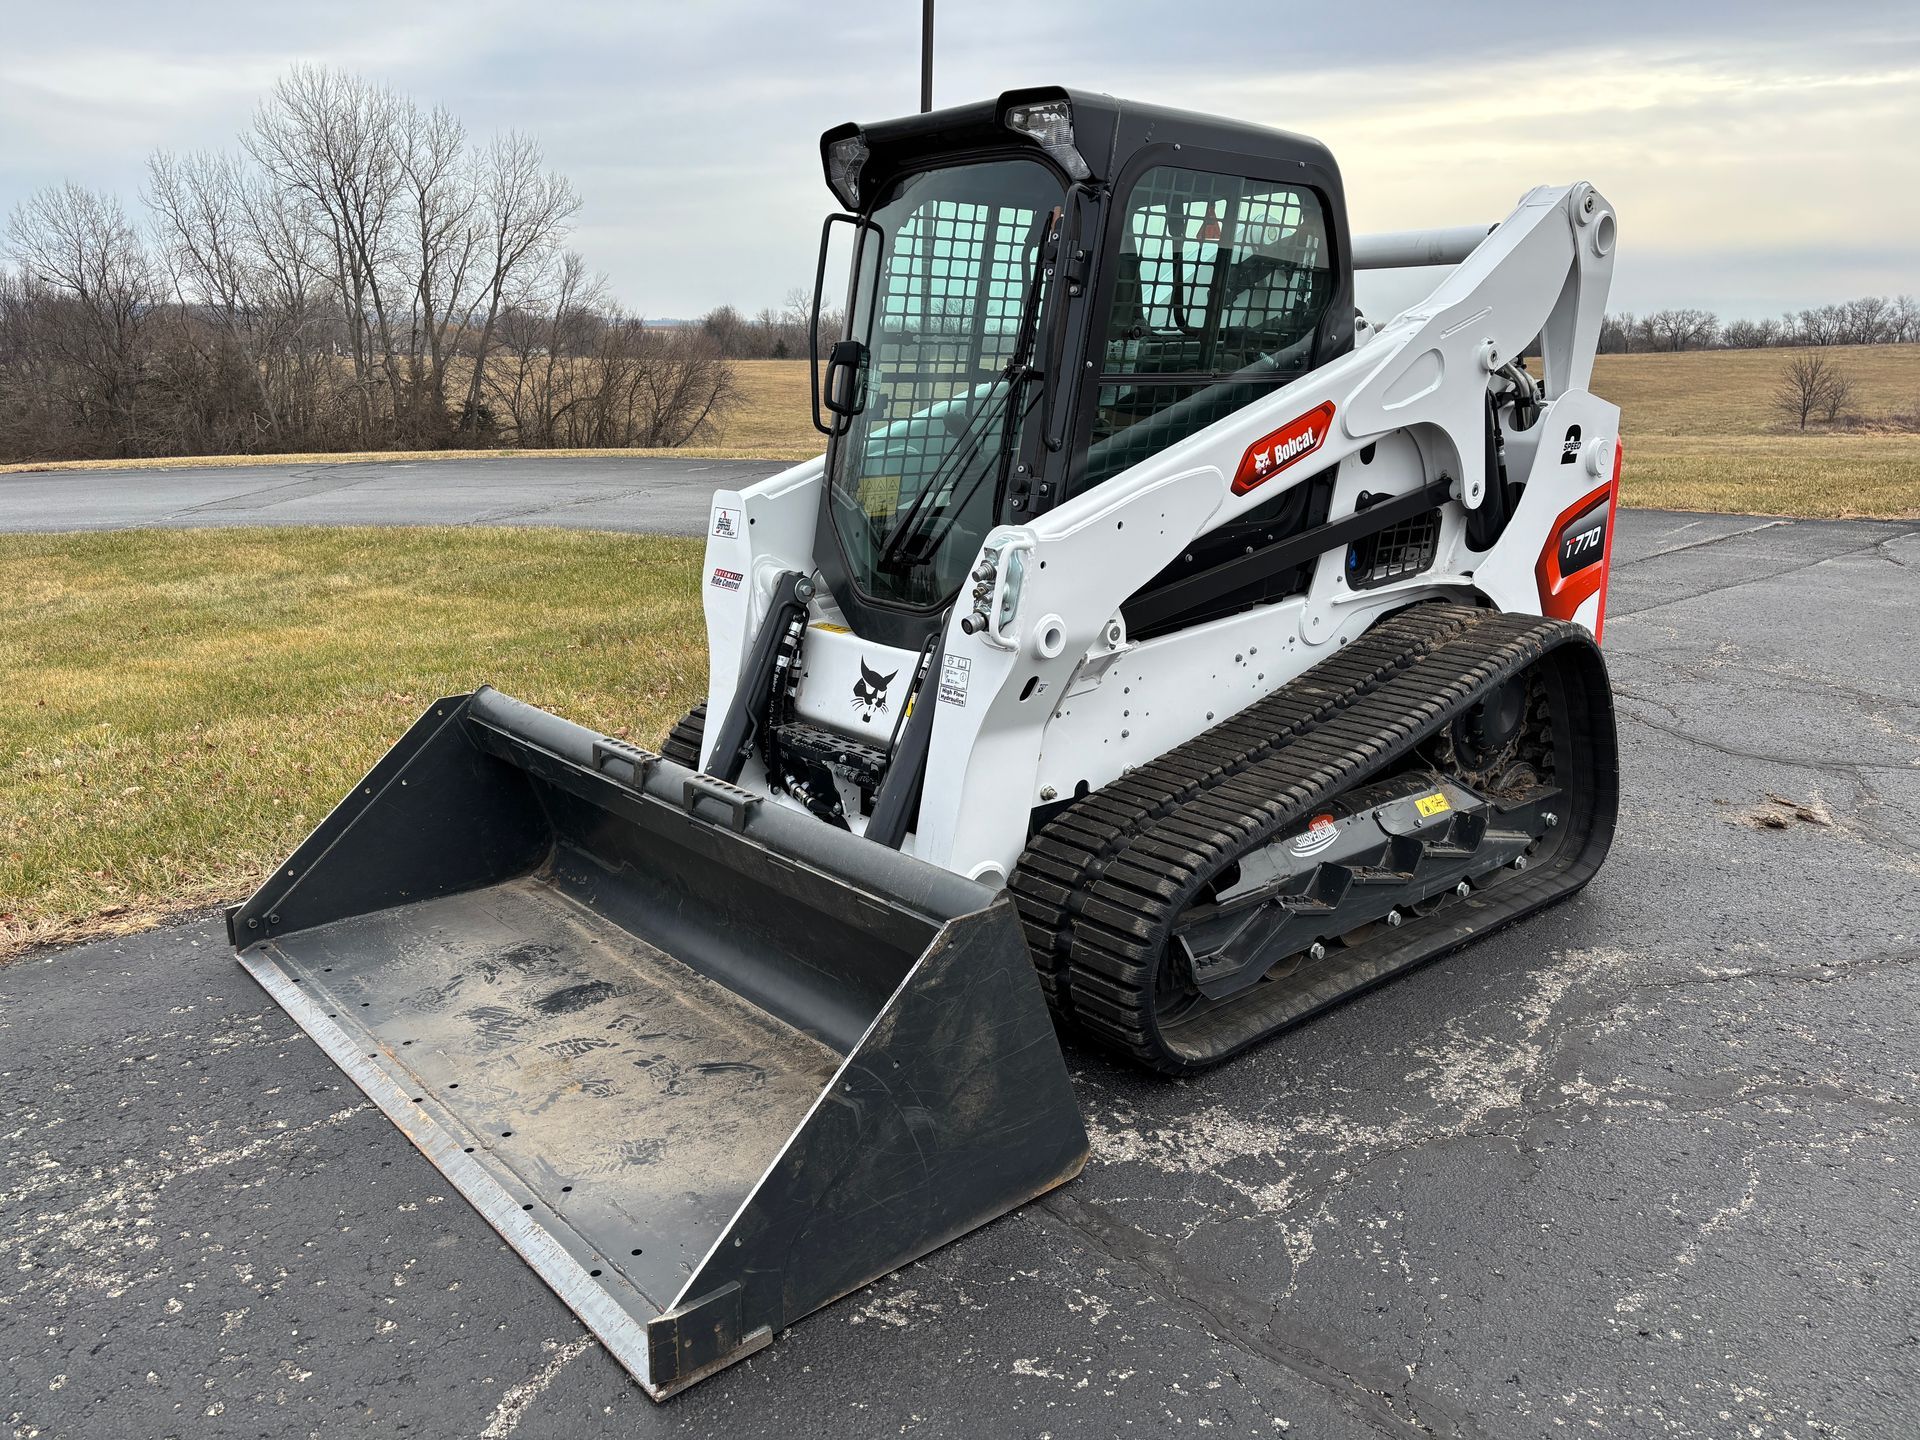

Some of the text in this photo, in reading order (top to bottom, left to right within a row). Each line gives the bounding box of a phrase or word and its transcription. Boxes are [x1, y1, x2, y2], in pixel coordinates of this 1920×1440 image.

[1274, 426, 1315, 465] Bobcat
[1560, 424, 1582, 464] 2
[1563, 441, 1582, 451] SPEED
[715, 569, 743, 581] AUTOMATIC
[711, 576, 741, 590] Ride Control
[941, 694, 964, 705] Hydraulics
[942, 688, 965, 698] High Flow
[1295, 822, 1337, 847] SUSPENSION
